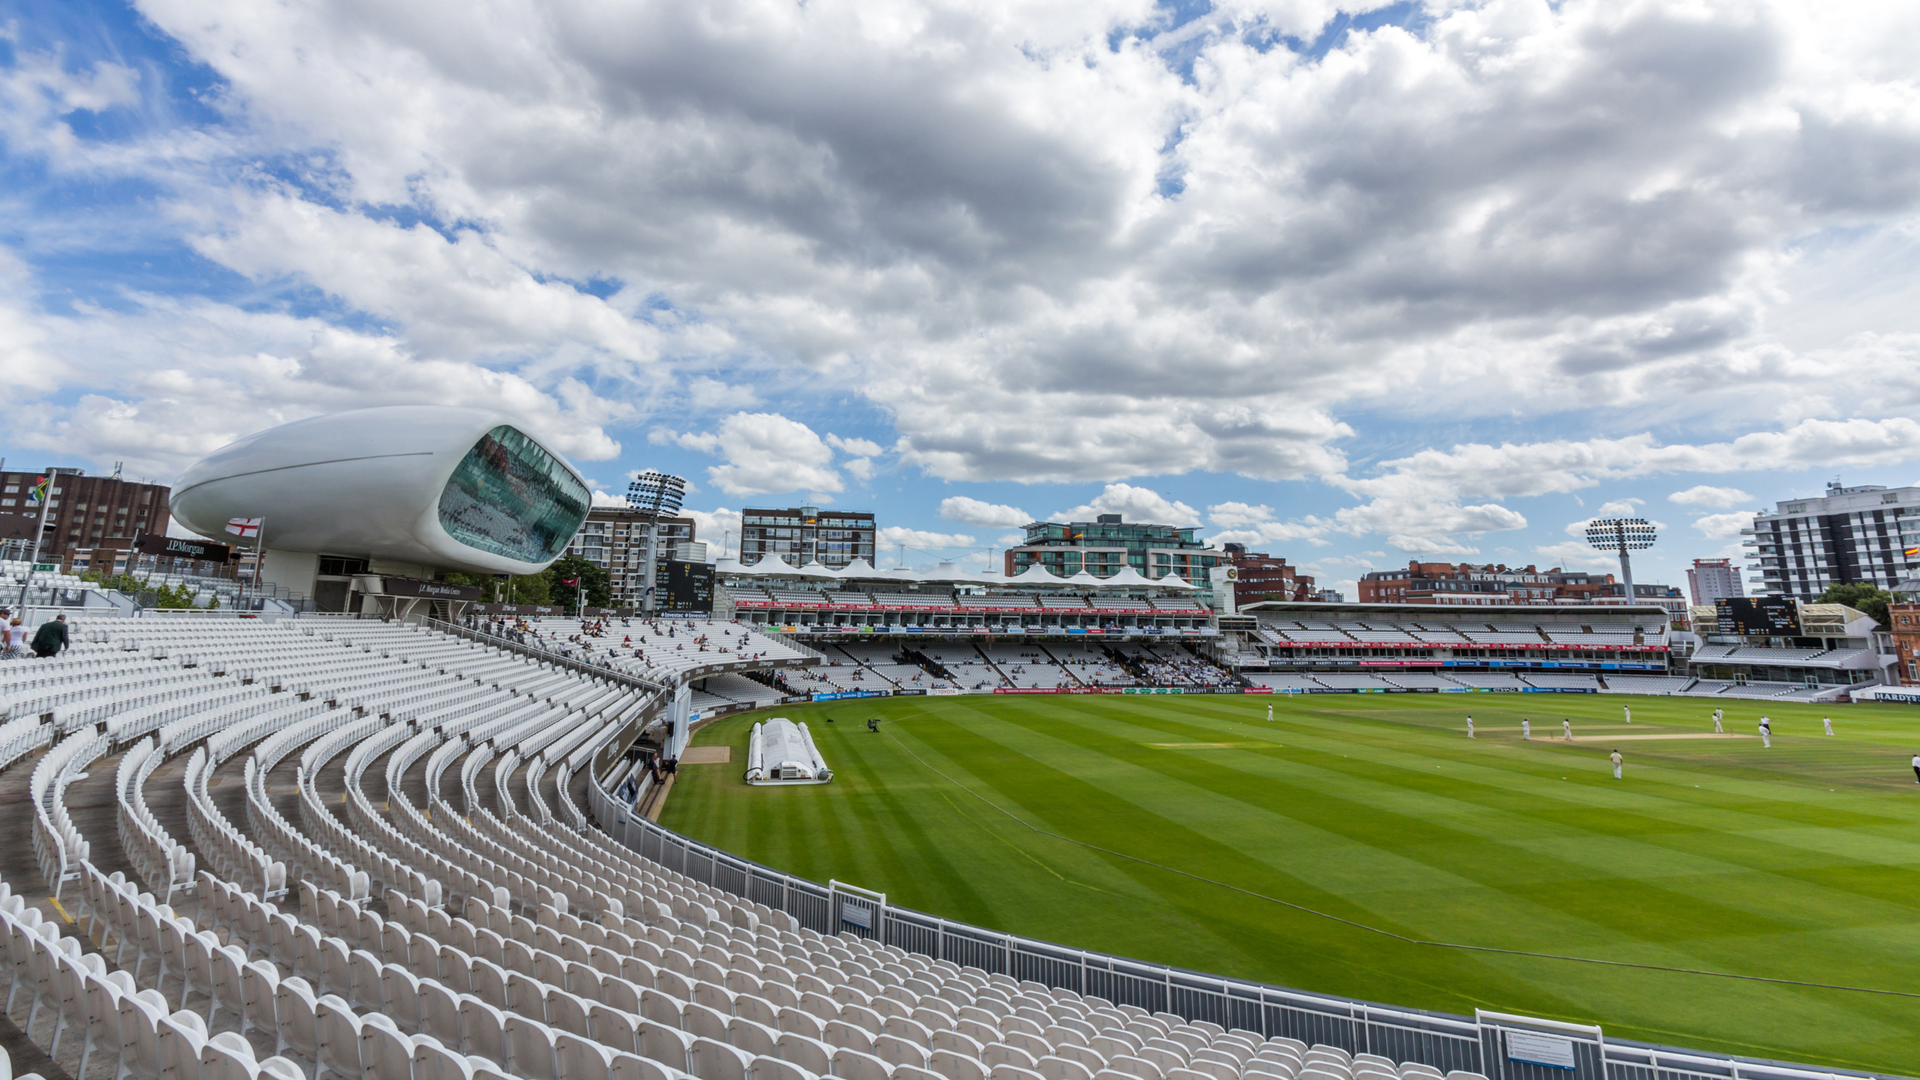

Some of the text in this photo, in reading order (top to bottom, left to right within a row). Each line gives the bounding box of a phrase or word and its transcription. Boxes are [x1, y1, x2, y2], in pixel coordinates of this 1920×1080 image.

[166, 540, 204, 556] J.P.Morgan
[426, 586, 440, 595] Morgan
[440, 586, 450, 594] Media
[1876, 693, 1917, 702] HARDYS
